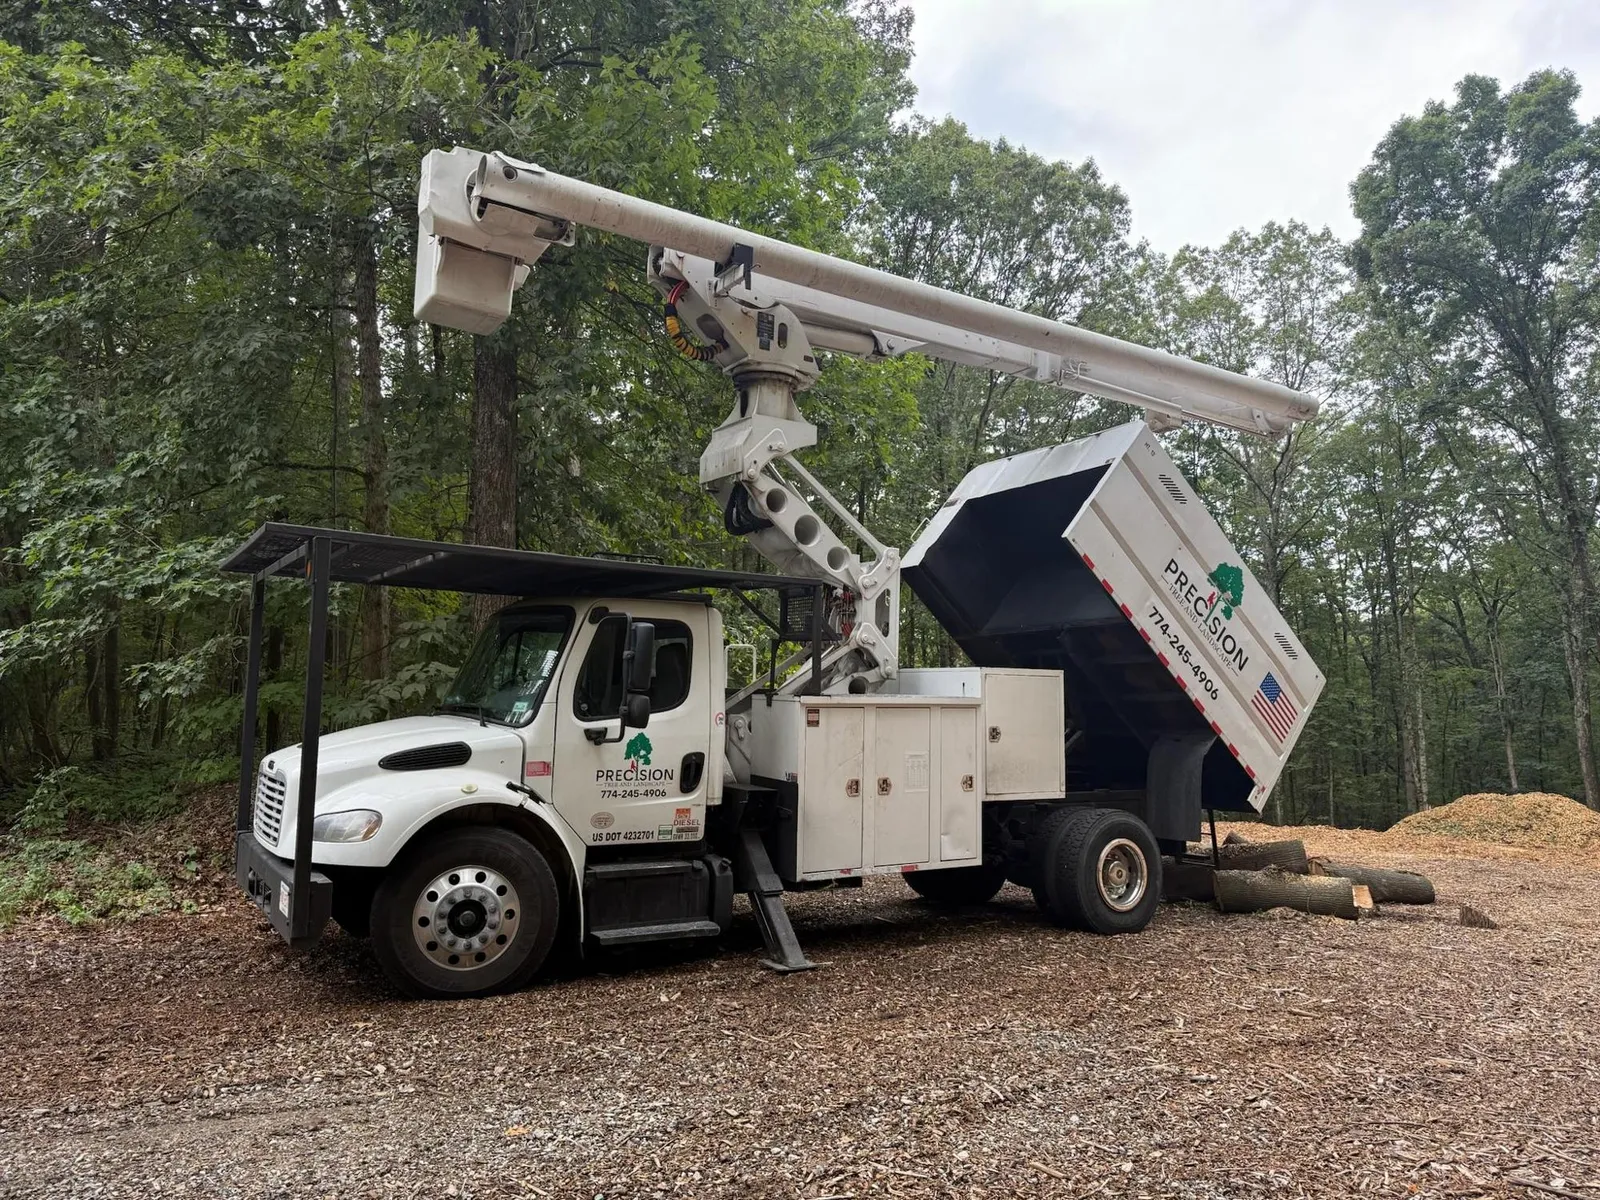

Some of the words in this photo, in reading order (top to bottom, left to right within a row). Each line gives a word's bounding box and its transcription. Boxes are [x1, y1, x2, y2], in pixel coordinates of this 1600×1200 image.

[1164, 558, 1249, 672] PRECISION
[1169, 583, 1186, 607] TREE
[1184, 606, 1198, 624] AND
[1197, 622, 1233, 669] LANDSCAPE
[1148, 606, 1220, 701] 774-245-4906
[596, 768, 674, 782] PRECISION
[601, 789, 667, 799] 774-245-4906
[592, 832, 603, 842] US
[605, 832, 622, 841] DOT
[623, 830, 655, 840] 4232701
